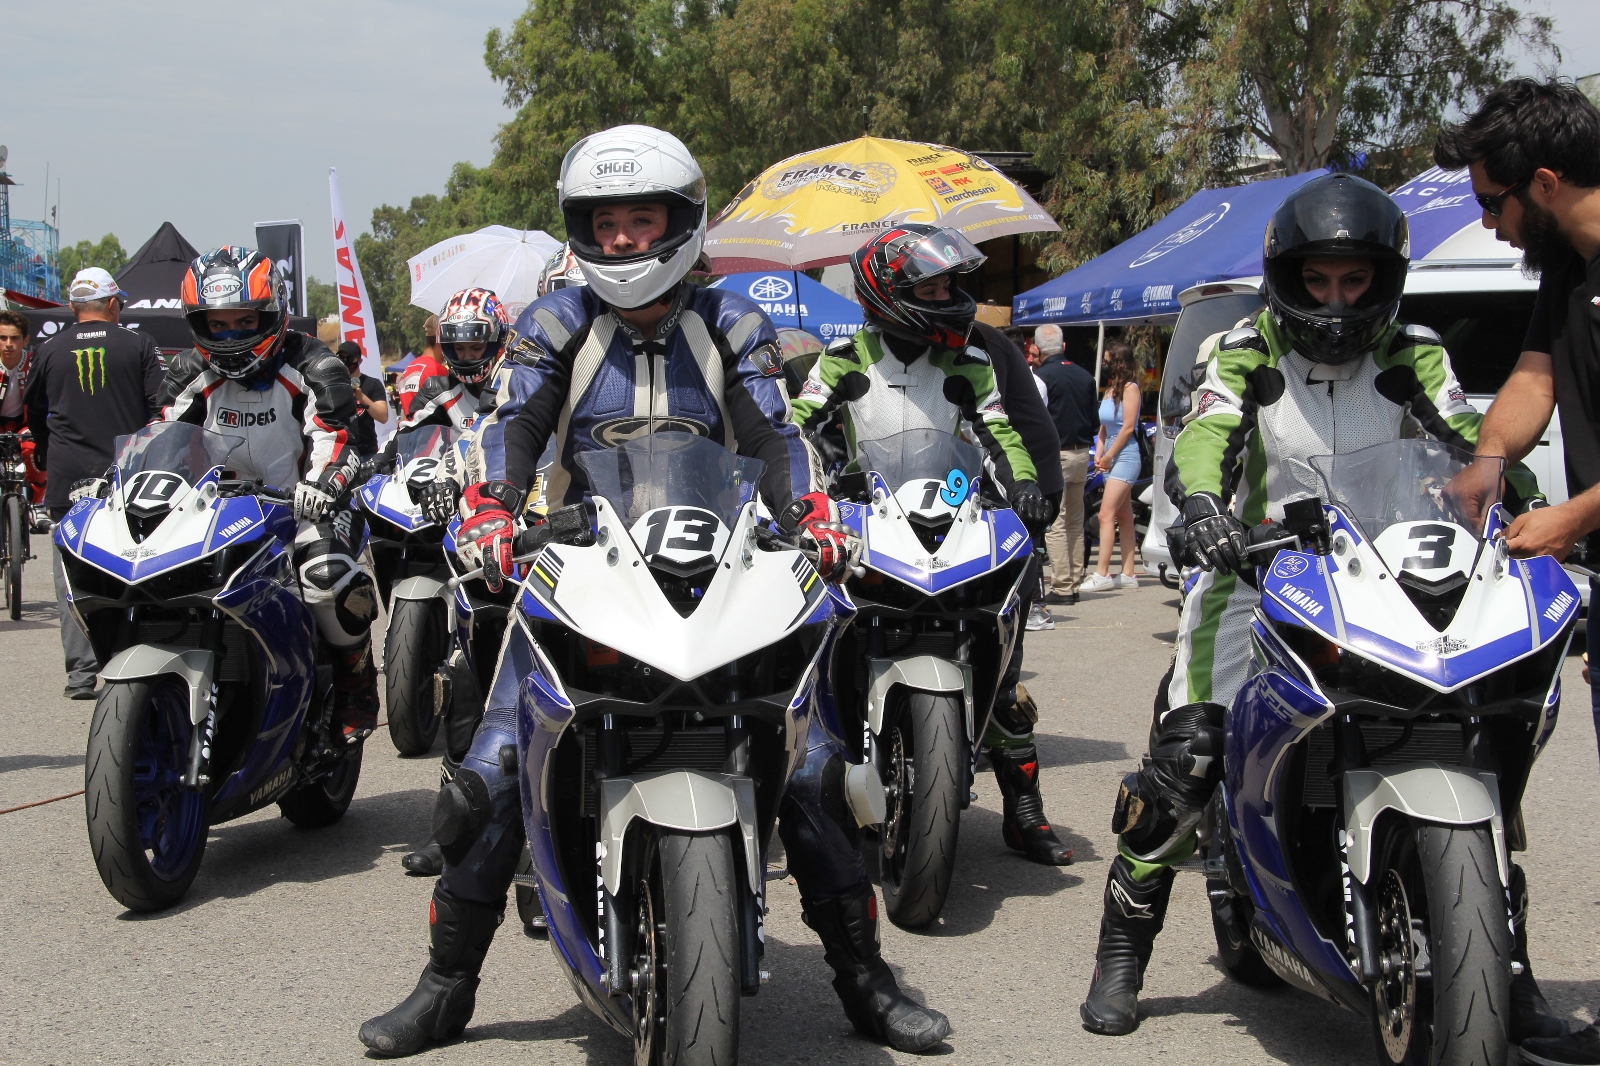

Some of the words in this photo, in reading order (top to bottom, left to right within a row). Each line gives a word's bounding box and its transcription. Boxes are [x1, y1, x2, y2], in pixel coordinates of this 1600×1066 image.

[596, 161, 635, 176] SHOEI
[780, 164, 866, 182] FRANCE
[777, 173, 833, 189] EQUIPEMENT
[951, 177, 973, 187] RK
[944, 185, 996, 205] marchesini
[842, 219, 900, 232] FRANCE
[204, 284, 240, 294] SUOMY
[1149, 284, 1175, 301] YAMAHA
[83, 330, 107, 339] YAMAHA
[410, 457, 440, 478] 2
[124, 472, 185, 502] 10
[919, 467, 971, 510] 19
[219, 516, 254, 539] YAMAHA
[643, 508, 720, 557] 13
[1000, 530, 1024, 553] YAMAHA
[1401, 523, 1458, 570] 3
[1278, 582, 1324, 618] YAMAHA
[1543, 590, 1575, 623] YAMAHA
[250, 766, 293, 806] YAMAHA
[1253, 925, 1316, 987] YAMAHA
